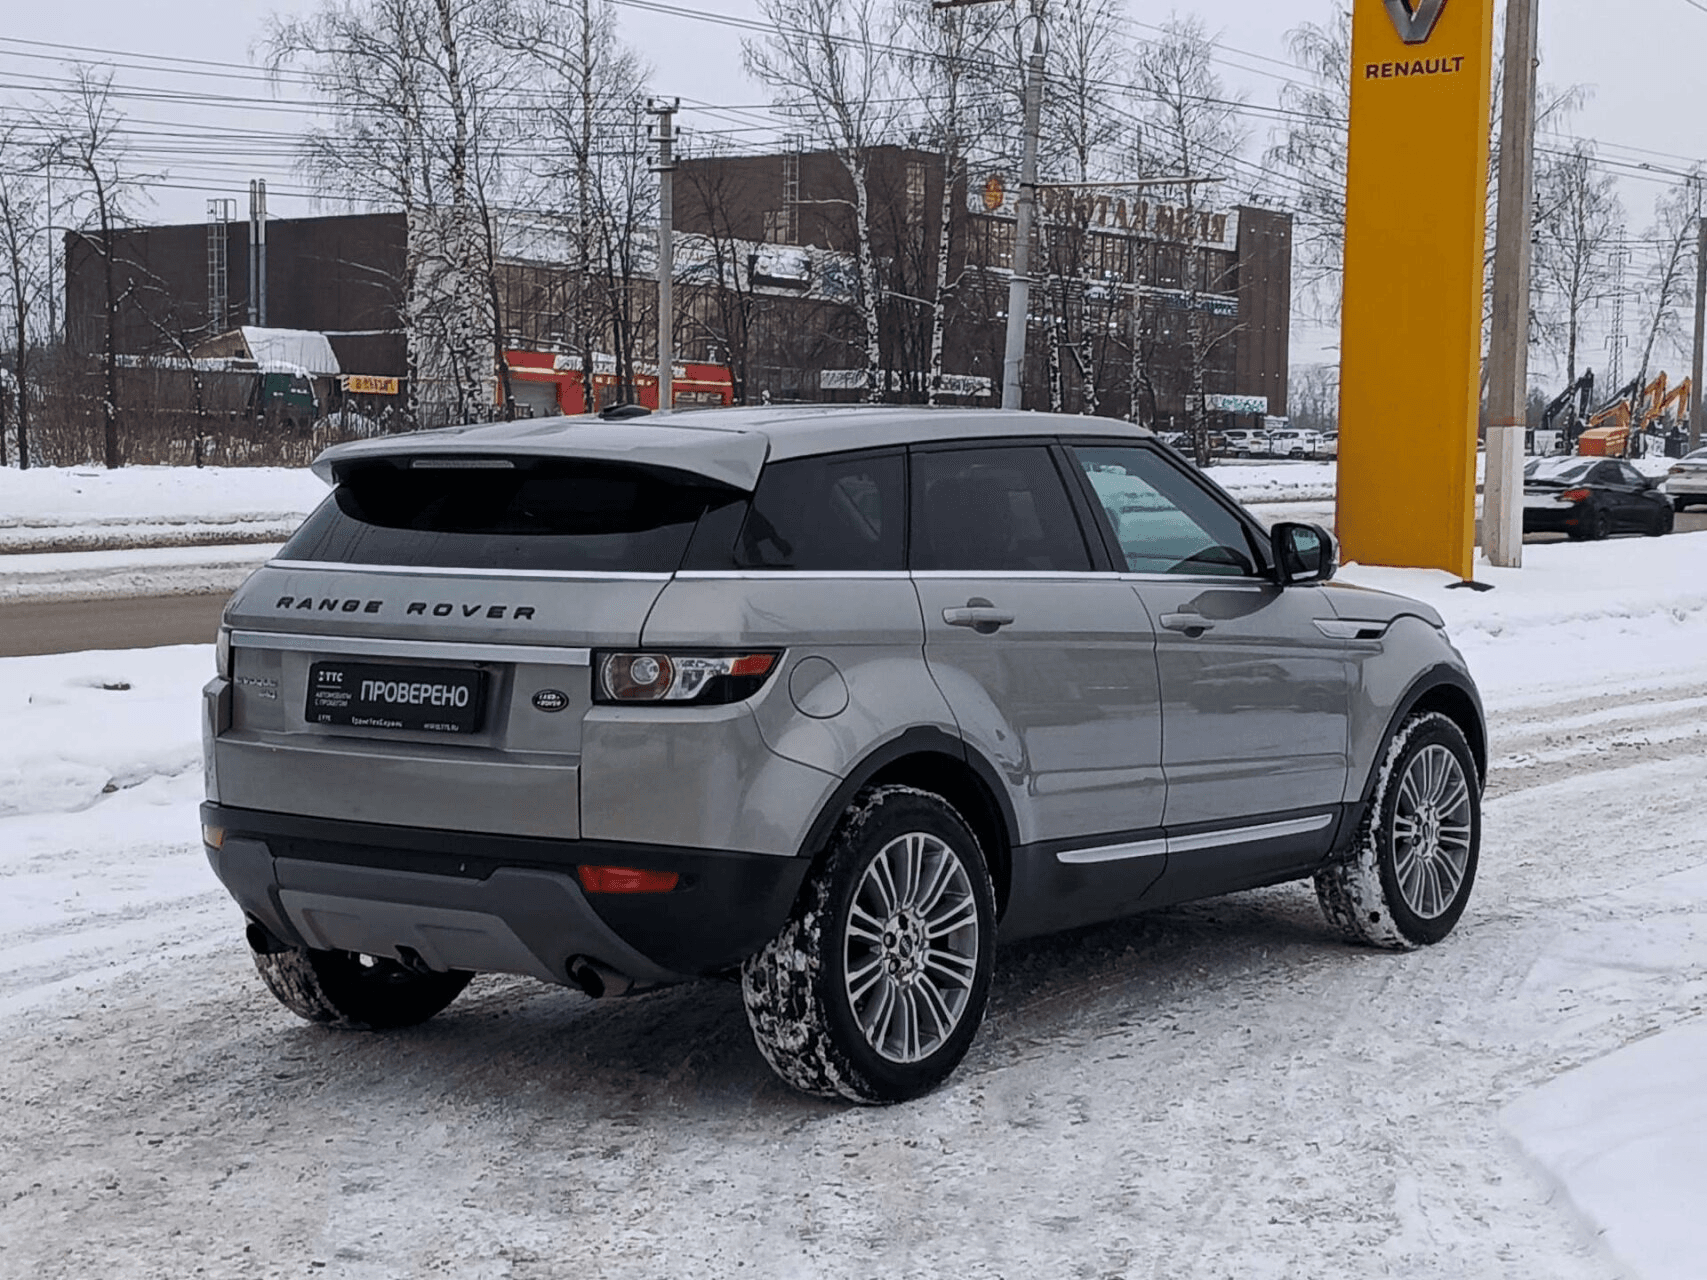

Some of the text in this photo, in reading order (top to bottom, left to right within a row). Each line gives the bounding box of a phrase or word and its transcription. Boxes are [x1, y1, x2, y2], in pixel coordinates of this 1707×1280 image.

[1365, 56, 1465, 79] RENAULT
[275, 596, 536, 620] RANGE ROVER
[360, 680, 470, 707] ПРОВЕРЕНО
